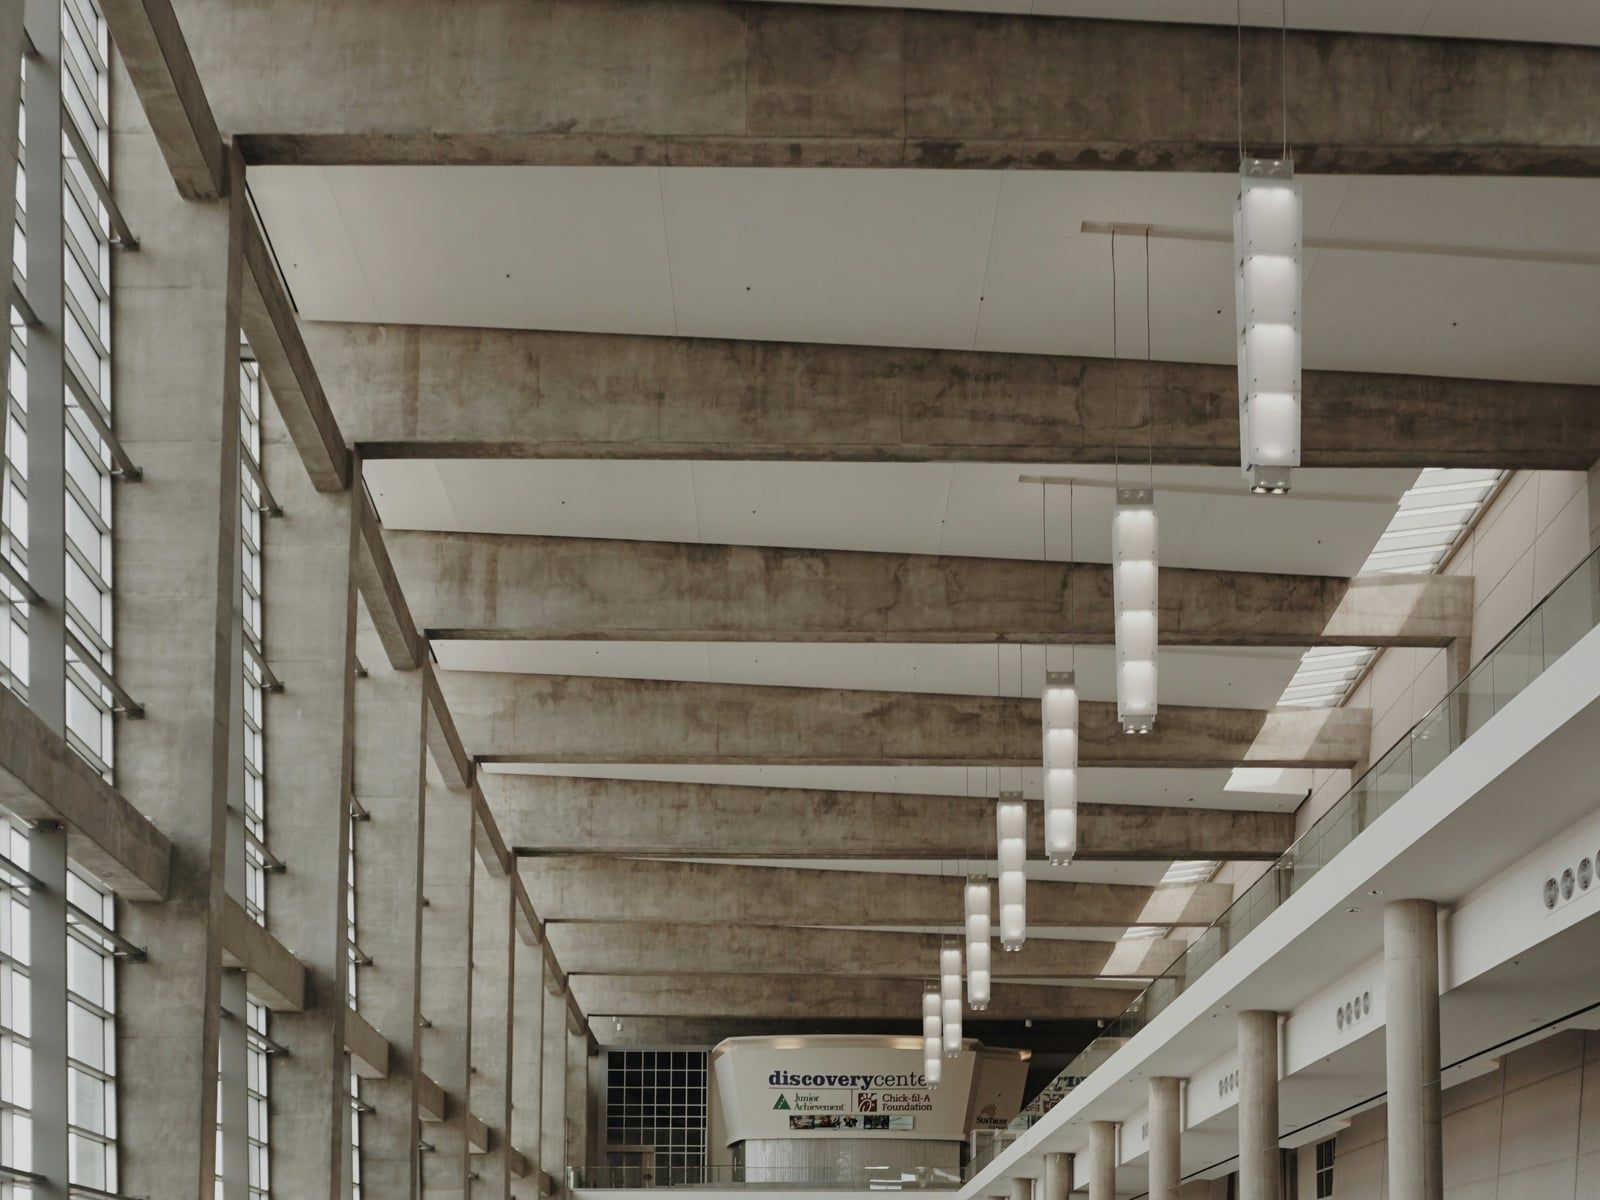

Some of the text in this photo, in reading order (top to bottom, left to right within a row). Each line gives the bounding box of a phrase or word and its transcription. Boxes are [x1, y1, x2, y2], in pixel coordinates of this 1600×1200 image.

[768, 1070, 928, 1091] discoverycente
[794, 1092, 820, 1102] Junior
[882, 1093, 931, 1103] Chick-fil-A
[794, 1102, 845, 1112] Achievement
[882, 1102, 933, 1112] Foundation
